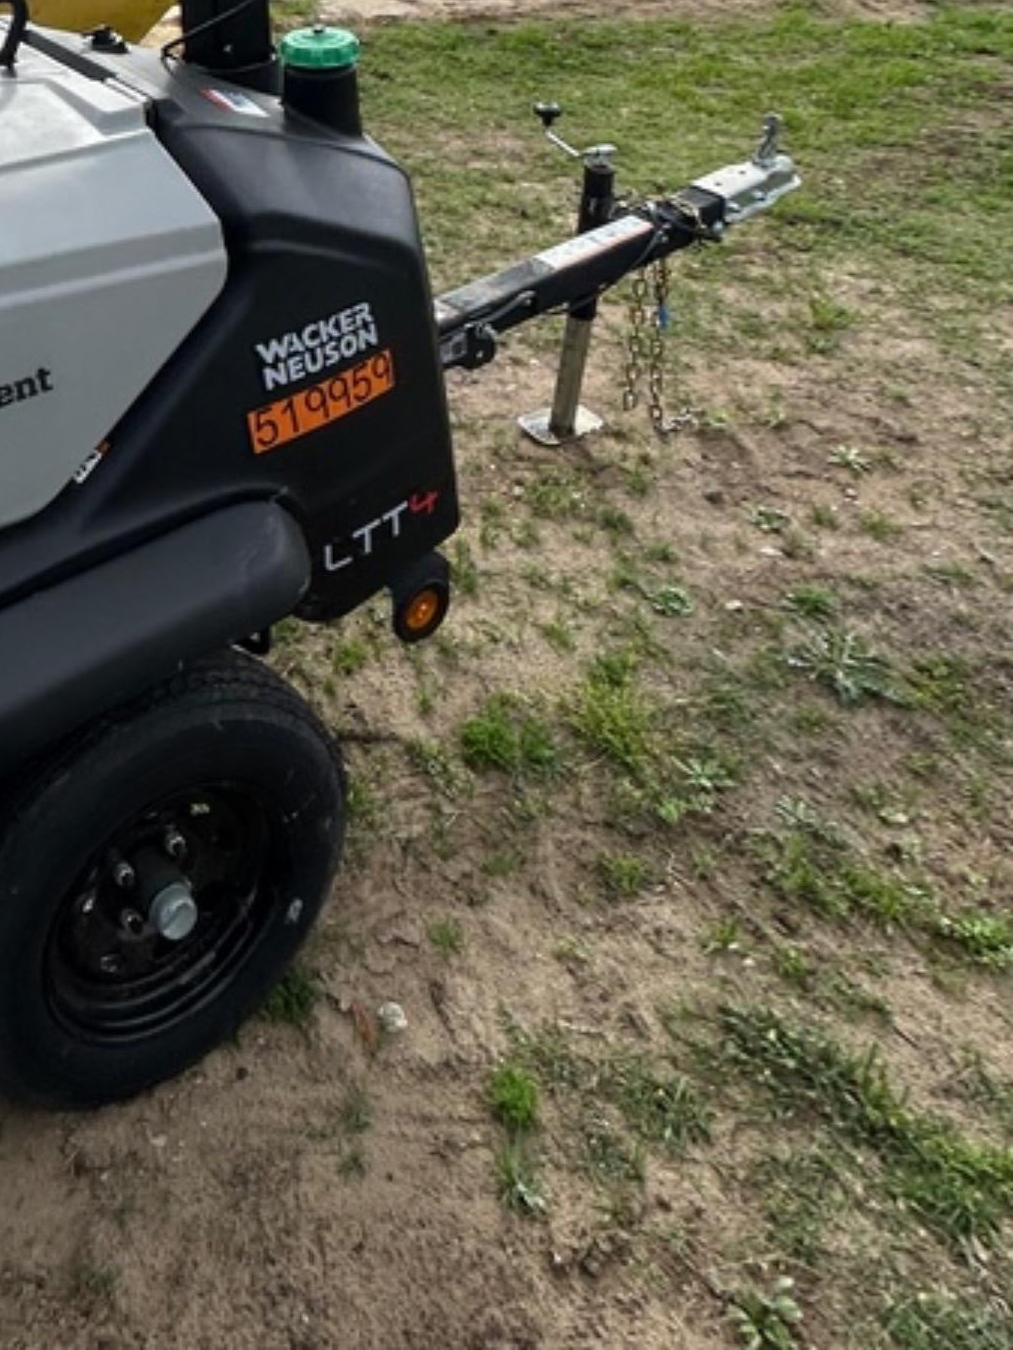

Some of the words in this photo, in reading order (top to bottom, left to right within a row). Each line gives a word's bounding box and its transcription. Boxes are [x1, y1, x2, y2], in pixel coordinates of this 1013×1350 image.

[256, 302, 374, 363] WACKER
[262, 322, 379, 391] NEUSON
[256, 357, 390, 447] 519959
